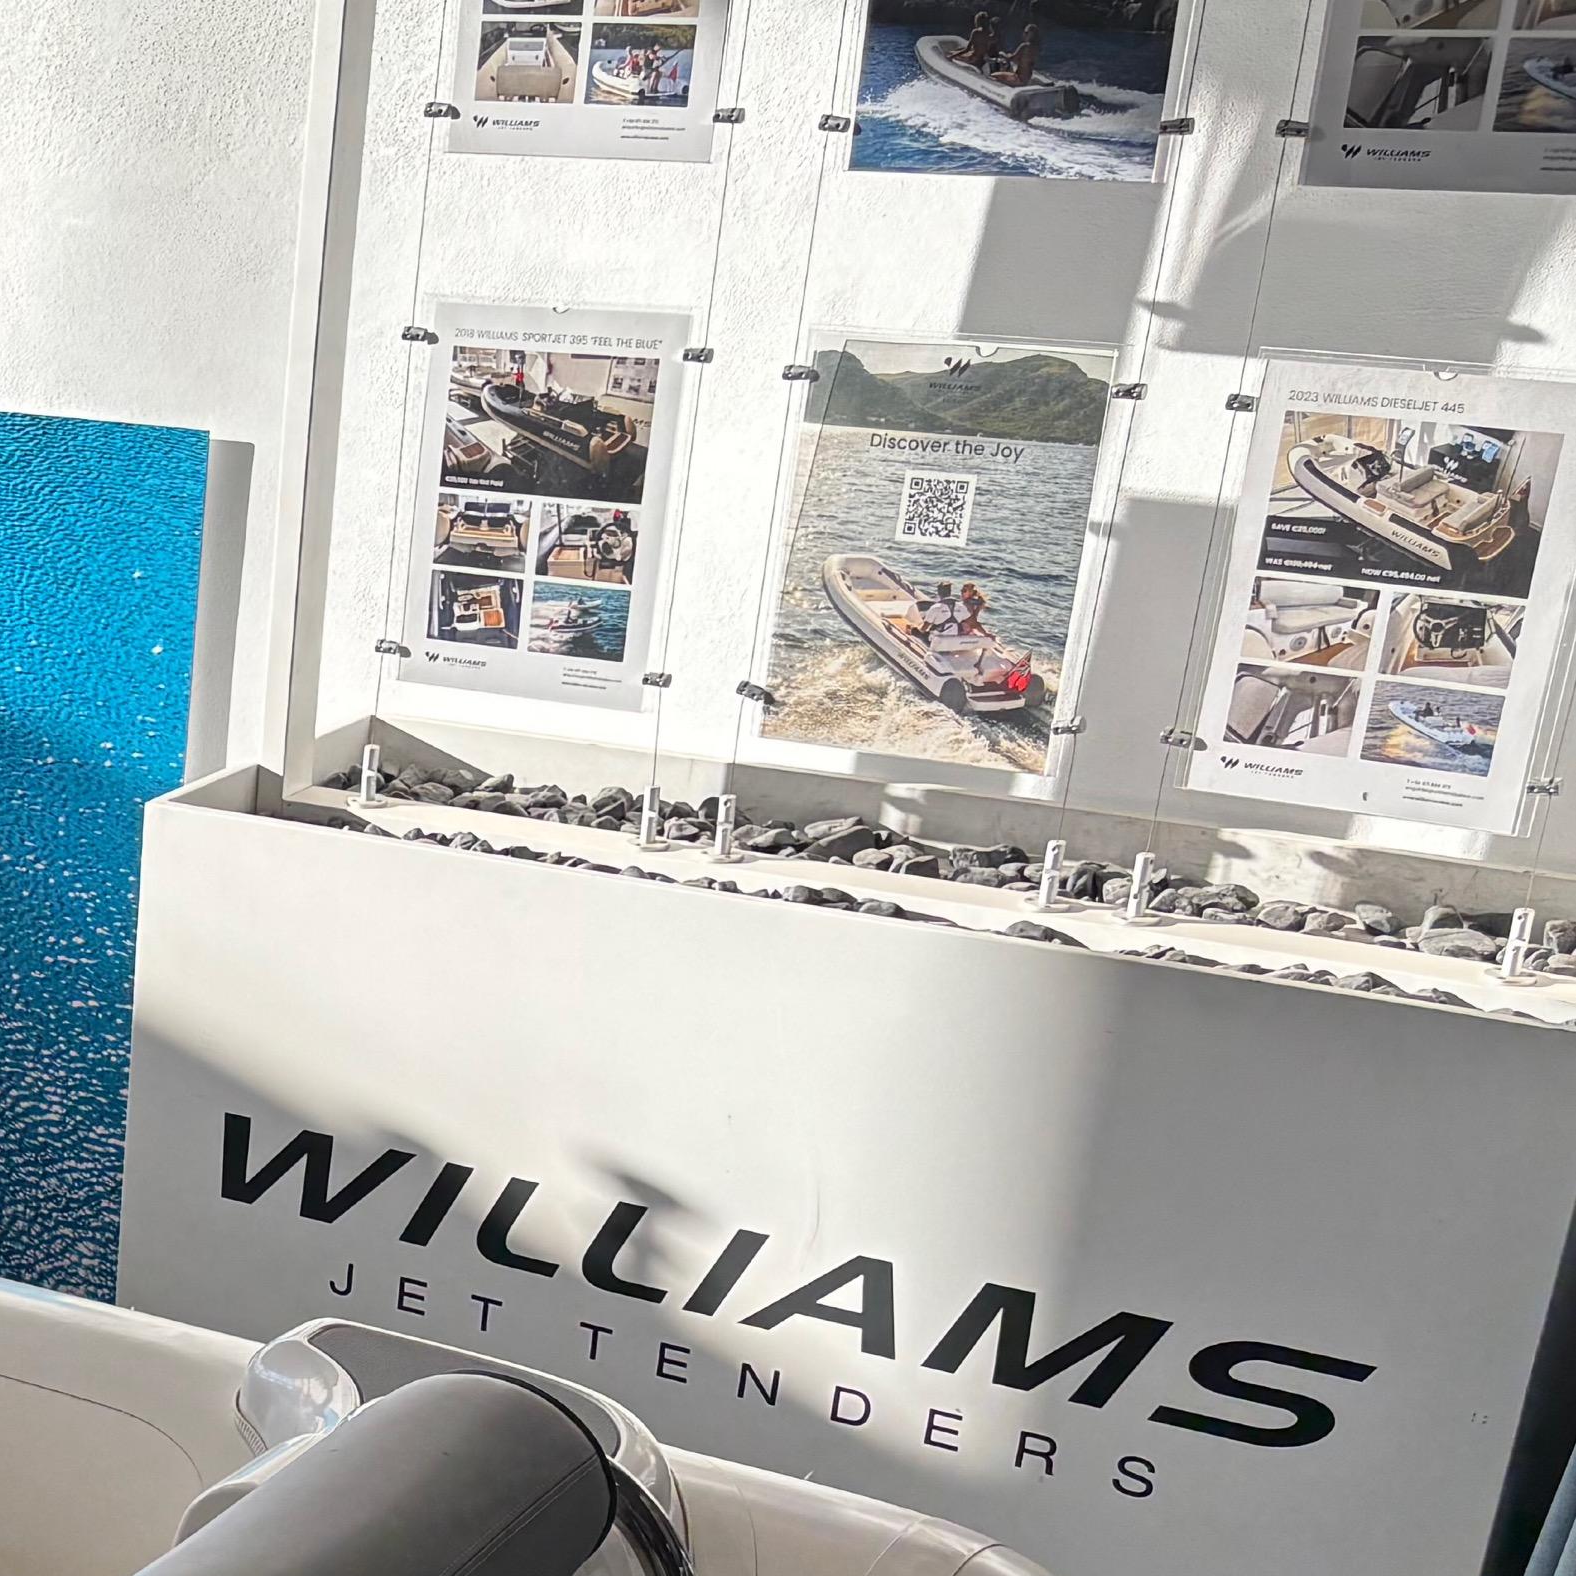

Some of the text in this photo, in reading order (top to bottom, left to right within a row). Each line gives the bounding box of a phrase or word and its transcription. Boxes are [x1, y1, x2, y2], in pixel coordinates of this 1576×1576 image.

[492, 119, 541, 127] WILLIAMS
[1366, 149, 1432, 157] WILLIAMS
[476, 329, 519, 341] WILLIAMS
[522, 332, 568, 344] SPORTJET
[570, 334, 589, 345] 395
[615, 338, 634, 349] THE
[1288, 389, 1465, 414] 2023 WILLIAMS DIESELJET 445
[869, 433, 1025, 464] Discover the Joy
[1391, 528, 1440, 558] WILLIAMS
[1243, 762, 1304, 776] WILLIAMS
[221, 1112, 1379, 1448] WILLIAMS
[329, 1261, 1156, 1498] JET TENDERS
